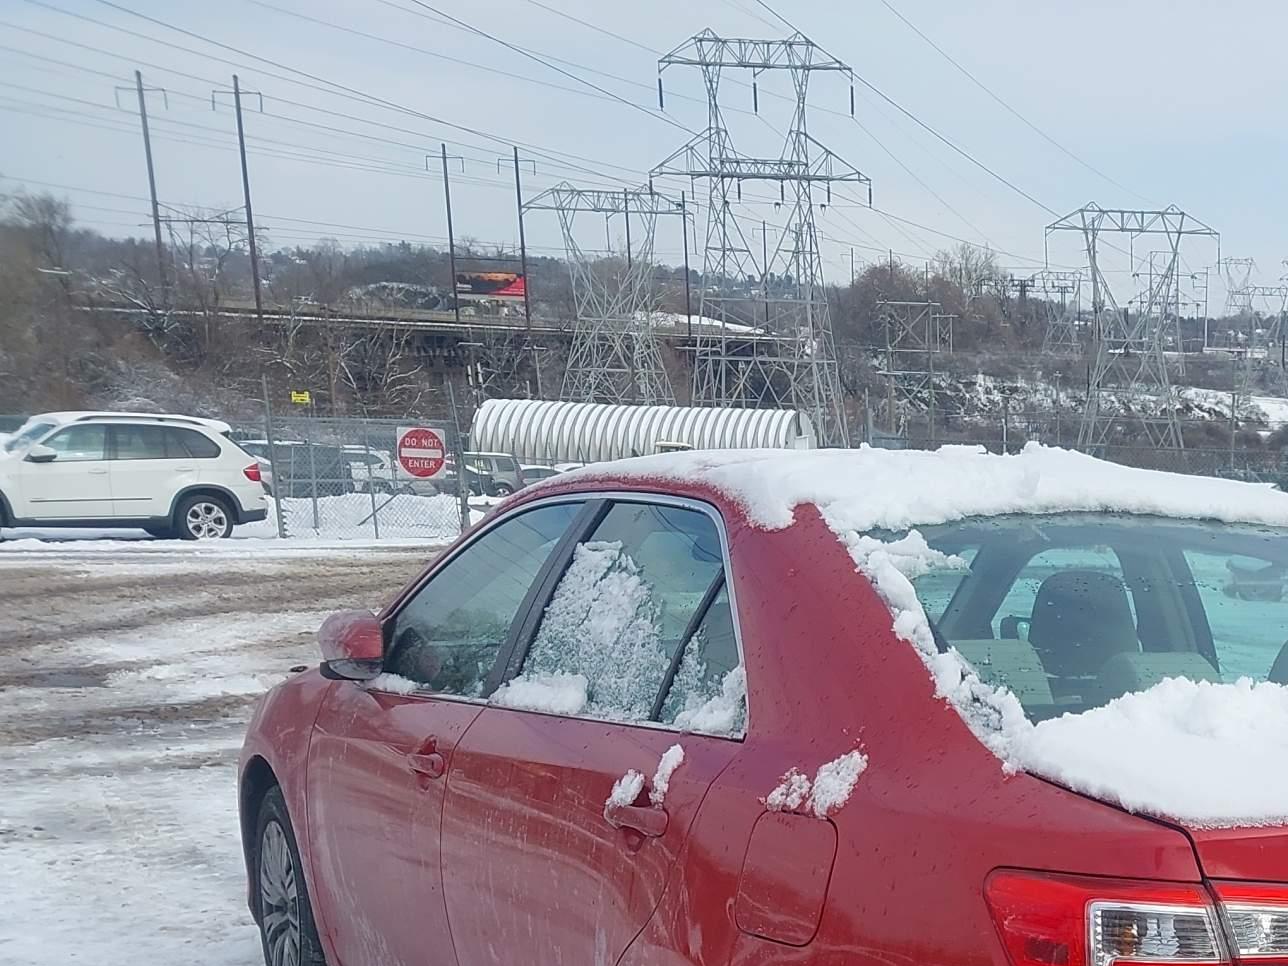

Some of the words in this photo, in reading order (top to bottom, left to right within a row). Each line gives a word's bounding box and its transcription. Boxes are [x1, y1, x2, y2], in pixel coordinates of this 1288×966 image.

[404, 437, 417, 446] DO
[421, 438, 438, 447] NOT
[408, 459, 435, 469] ENTER
